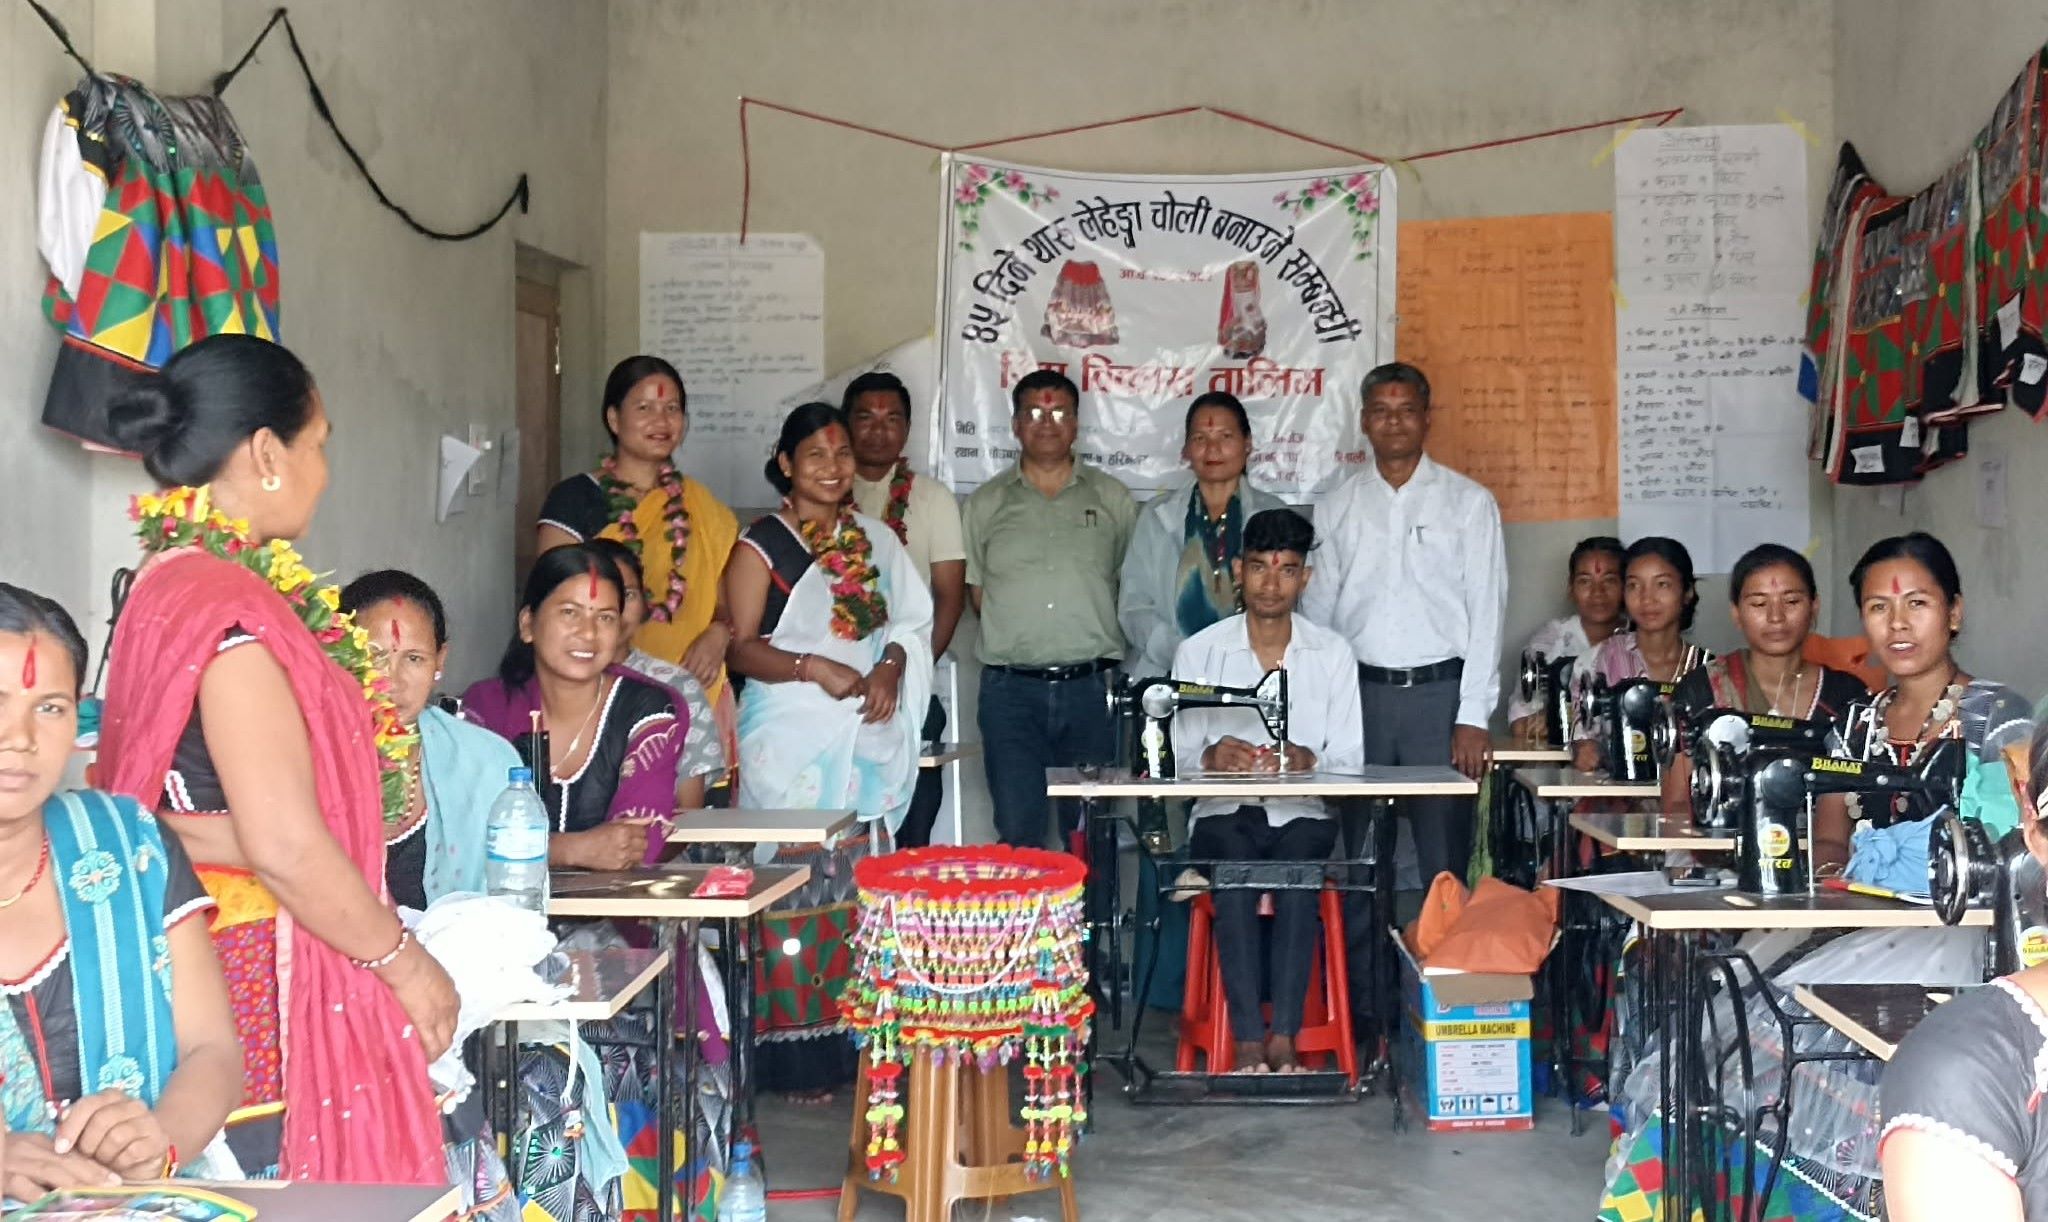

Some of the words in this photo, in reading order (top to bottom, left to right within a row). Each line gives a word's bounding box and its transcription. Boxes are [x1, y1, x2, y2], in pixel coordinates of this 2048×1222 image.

[1149, 190, 1212, 235] चोली
[1211, 209, 1295, 264] बनाउने
[1811, 757, 1862, 774] BHARAT
[1436, 1024, 1477, 1036] UMBRELLA
[1480, 1022, 1516, 1034] MACHINE
